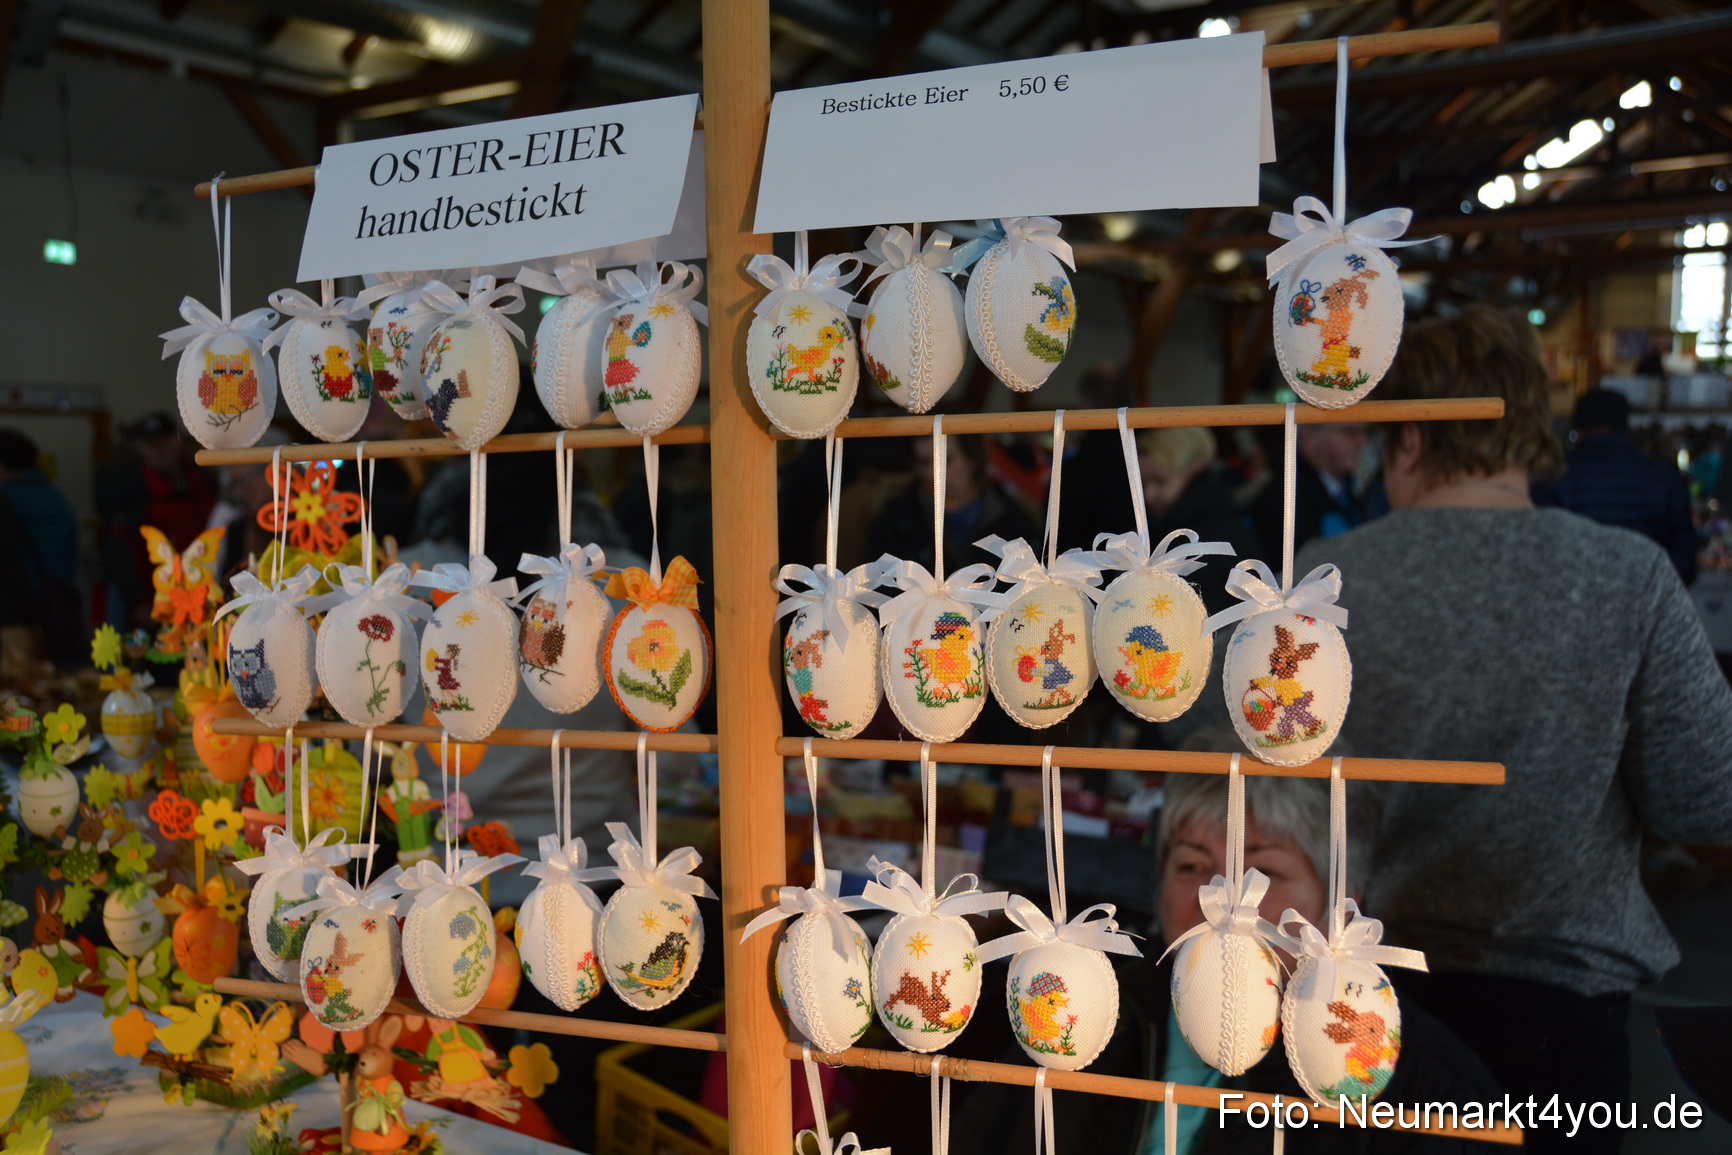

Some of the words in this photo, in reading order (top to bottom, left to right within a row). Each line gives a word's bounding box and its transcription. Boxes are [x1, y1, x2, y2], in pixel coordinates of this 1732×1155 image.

[820, 91, 917, 115] Bestickte
[924, 86, 969, 105] Eier
[999, 76, 1047, 99] 5,50
[1053, 74, 1070, 92] €
[369, 122, 626, 186] OSTER-EIER
[355, 183, 587, 239] handbestickt
